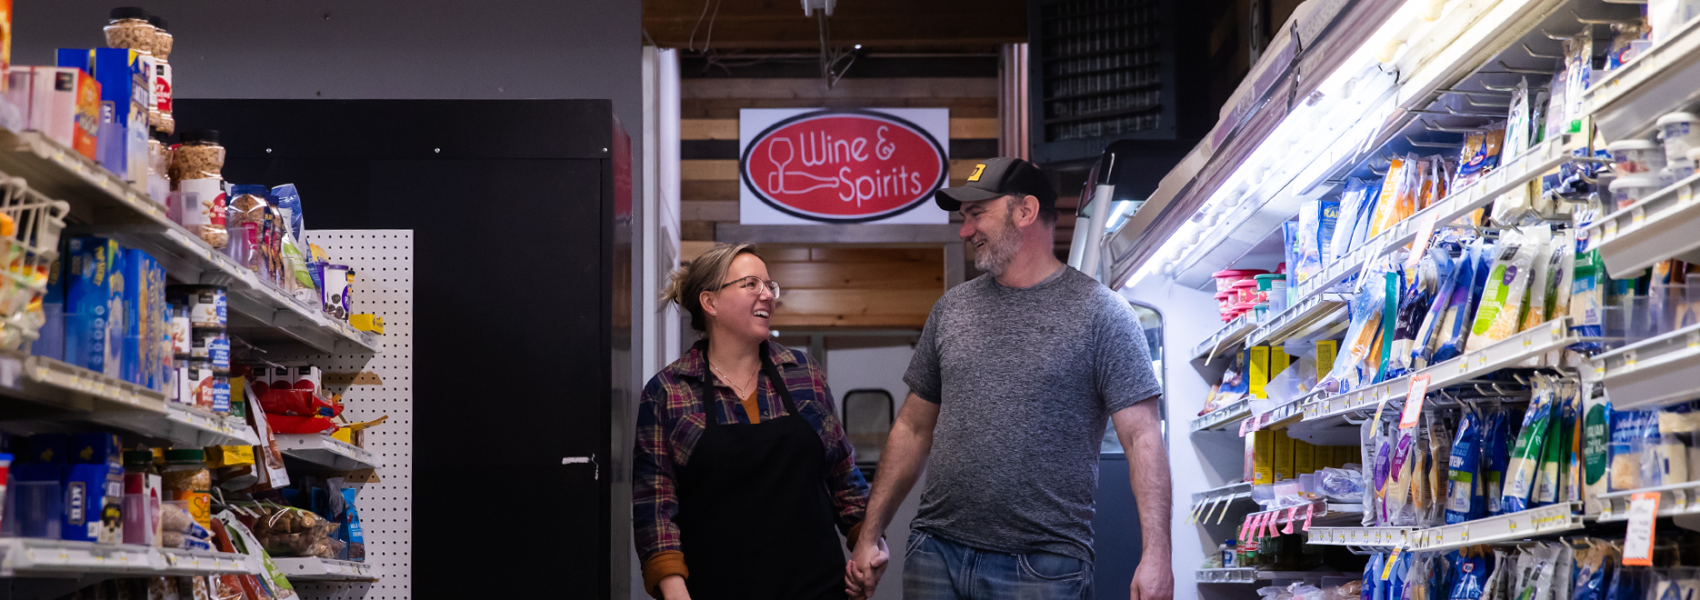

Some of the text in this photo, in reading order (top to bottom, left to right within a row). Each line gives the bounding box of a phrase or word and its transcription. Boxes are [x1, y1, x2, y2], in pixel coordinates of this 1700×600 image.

[800, 125, 896, 166] Wine &
[838, 165, 922, 208] Spirits
[1323, 208, 1339, 218] RAN
